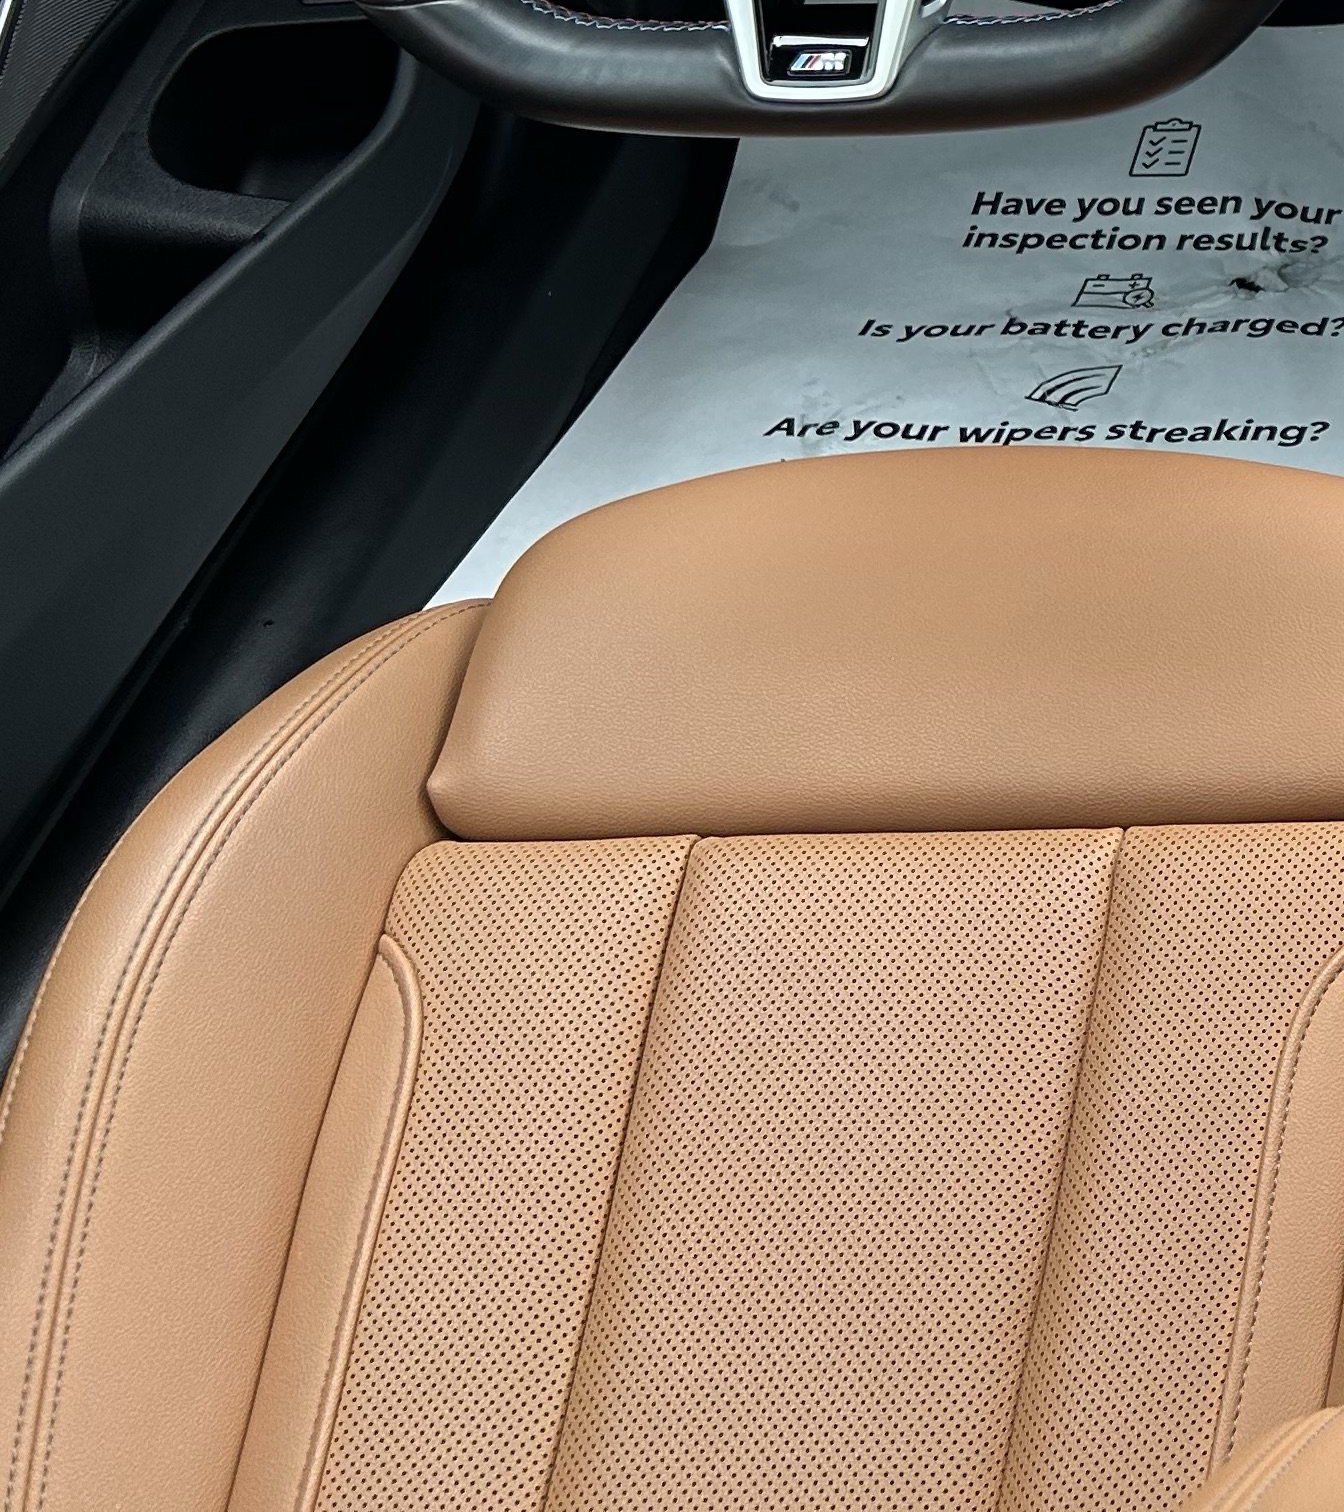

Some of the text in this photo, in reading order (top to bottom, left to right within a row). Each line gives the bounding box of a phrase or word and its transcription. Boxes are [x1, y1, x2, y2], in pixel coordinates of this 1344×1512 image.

[971, 191, 1343, 225] Have you seen your
[962, 225, 1329, 254] inspection results?
[858, 318, 892, 337] Is
[897, 322, 995, 342] your
[1001, 318, 1153, 345] battery
[764, 417, 1331, 447] Are your wipers streaking?
